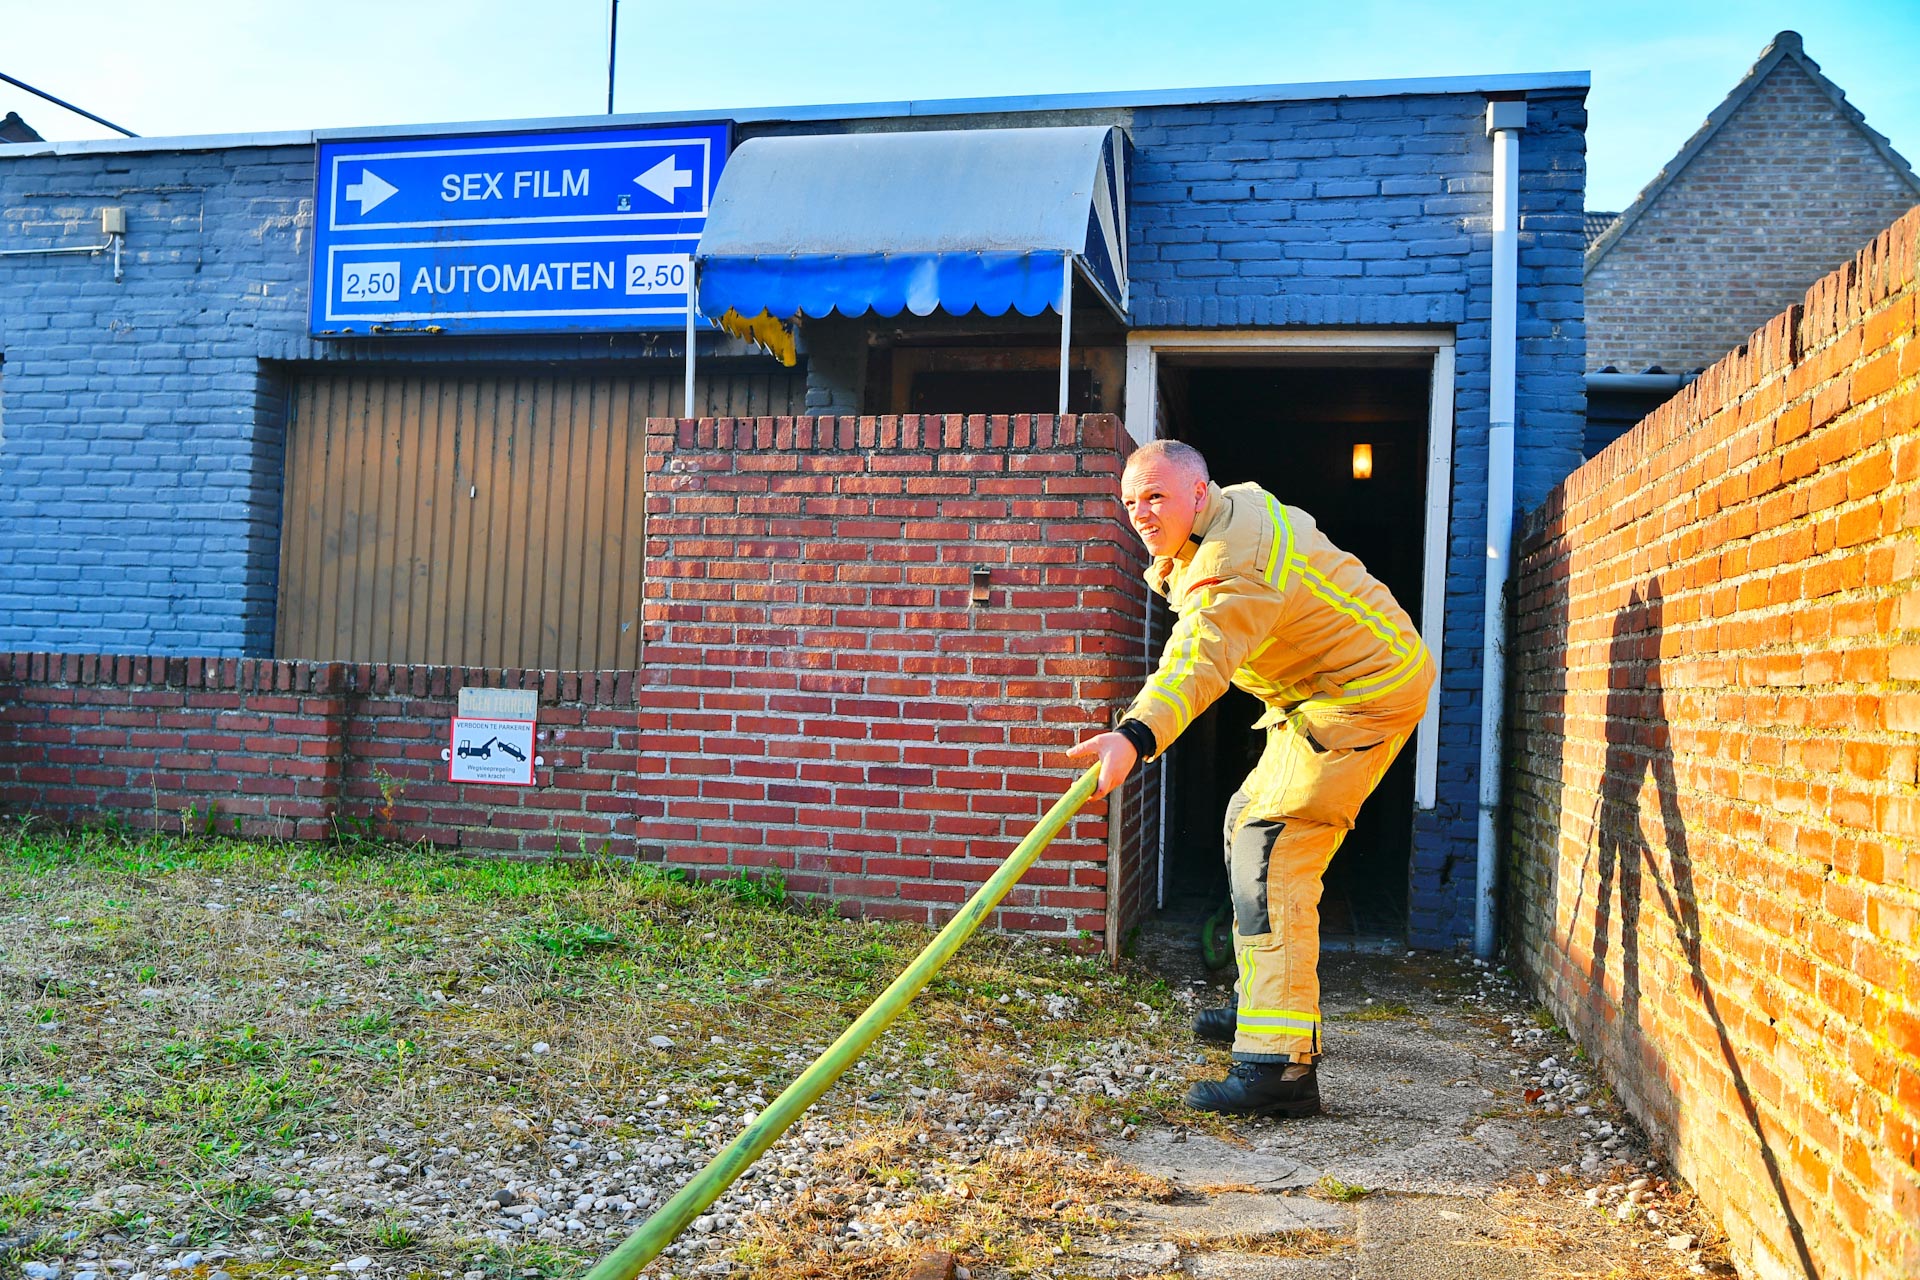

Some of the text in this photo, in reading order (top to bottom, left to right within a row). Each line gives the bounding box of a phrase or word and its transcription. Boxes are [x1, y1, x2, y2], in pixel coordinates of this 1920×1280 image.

[441, 168, 590, 202] SEX FILM
[346, 261, 685, 298] 2,50 AUTOMATEN 2,50
[456, 722, 489, 730] VERBODEN
[467, 764, 516, 773] Wegsleepregeling
